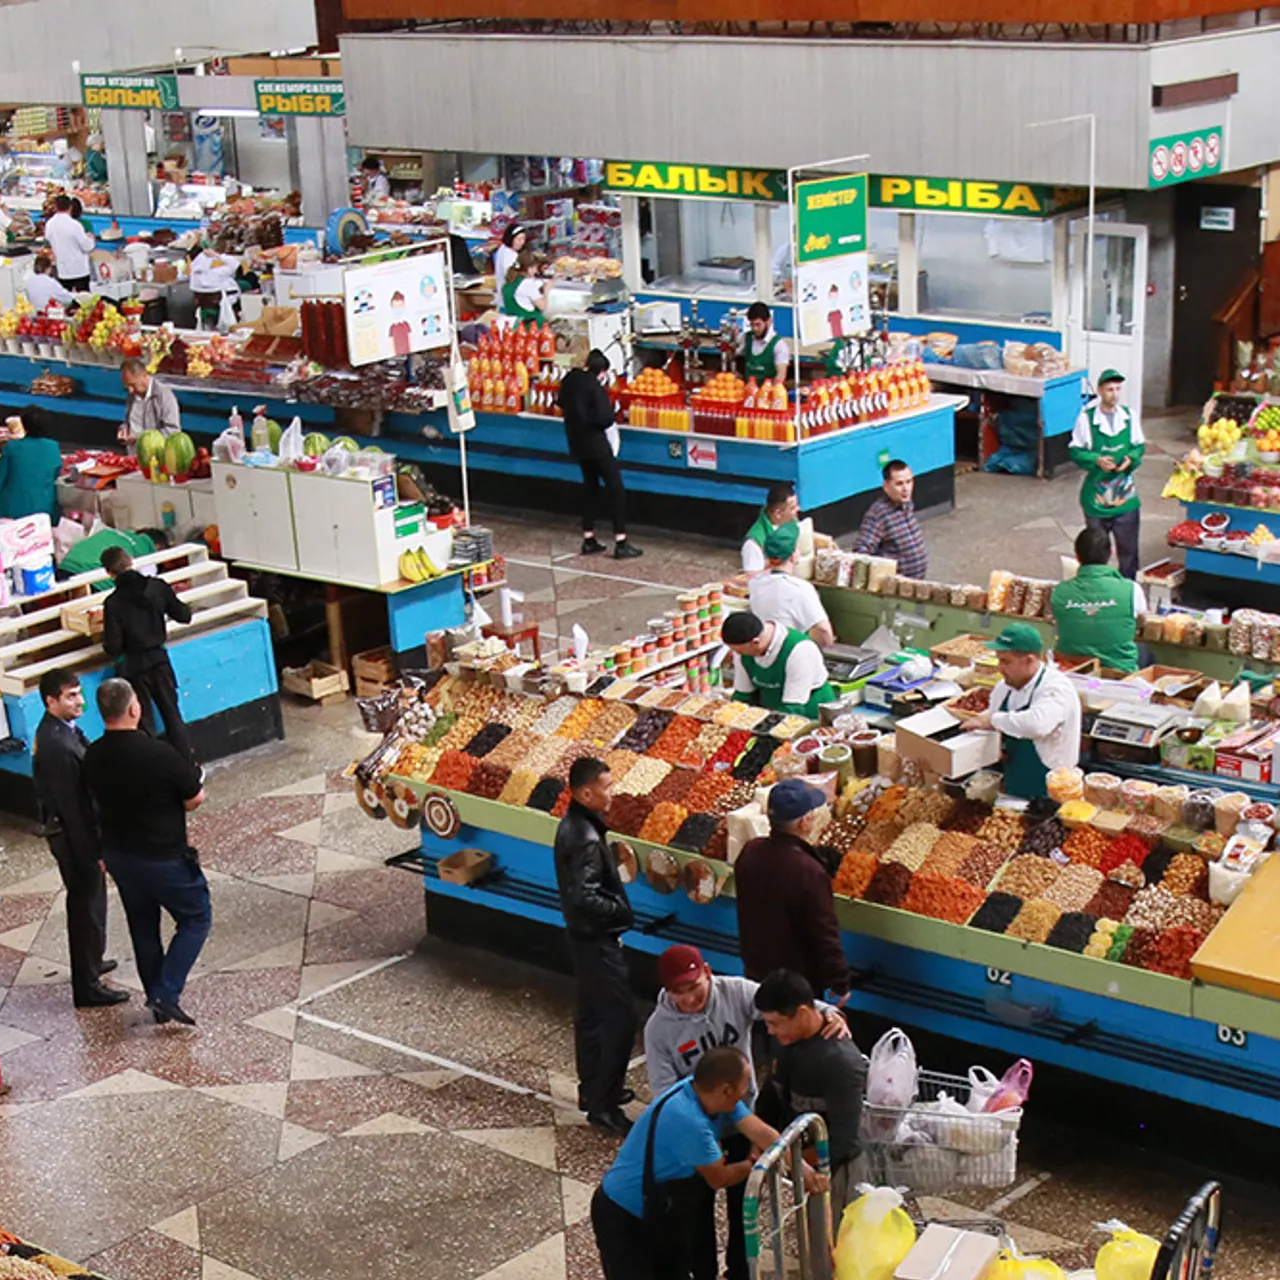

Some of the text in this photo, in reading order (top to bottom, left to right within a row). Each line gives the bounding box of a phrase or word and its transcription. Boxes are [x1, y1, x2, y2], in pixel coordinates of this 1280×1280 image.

[260, 94, 332, 113] РЫБА
[606, 162, 773, 199] БАЛЫҚ
[880, 177, 1042, 212] РЫБА
[1218, 1023, 1247, 1046] 63
